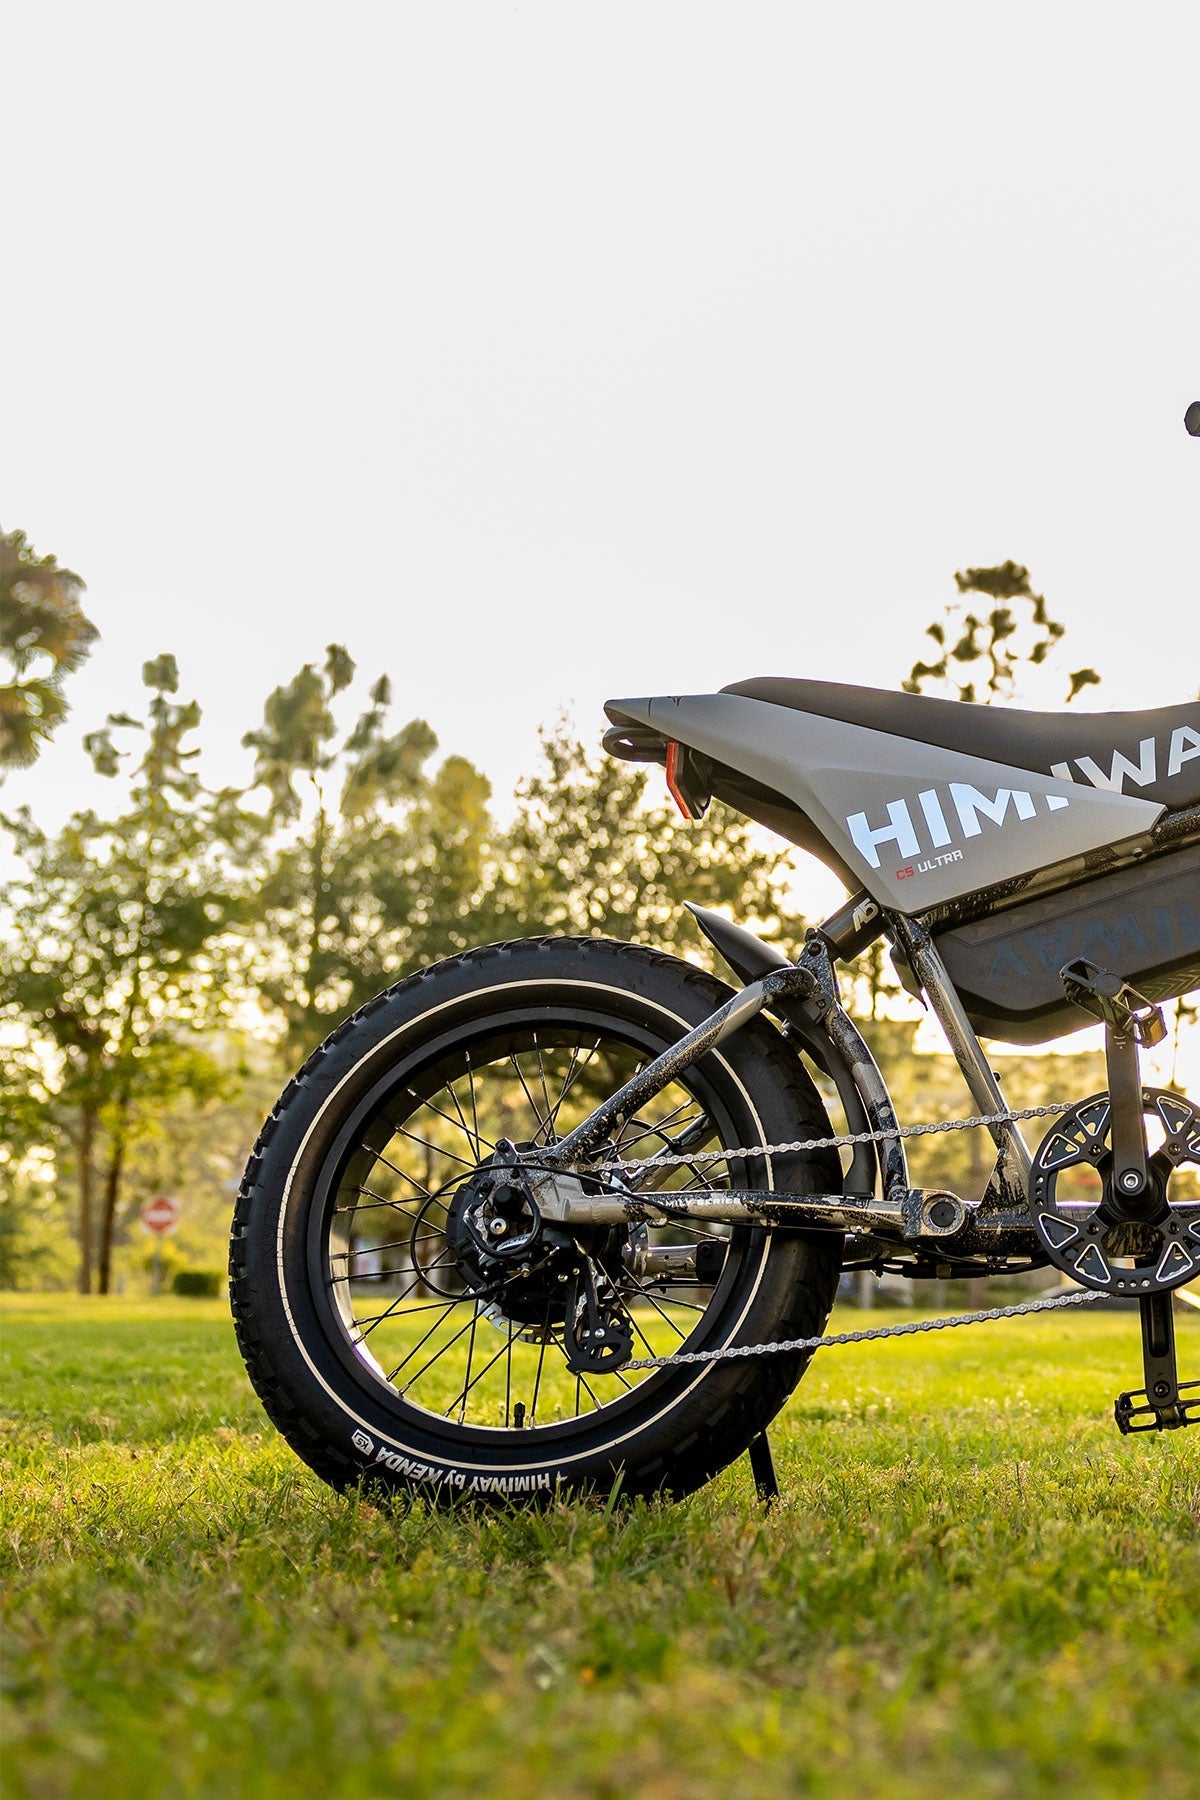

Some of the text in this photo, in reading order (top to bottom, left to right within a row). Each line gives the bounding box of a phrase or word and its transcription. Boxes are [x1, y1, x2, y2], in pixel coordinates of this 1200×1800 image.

[896, 850, 963, 881] C5 ULTRA
[375, 1446, 550, 1493] HIMIWAY by KENDA
